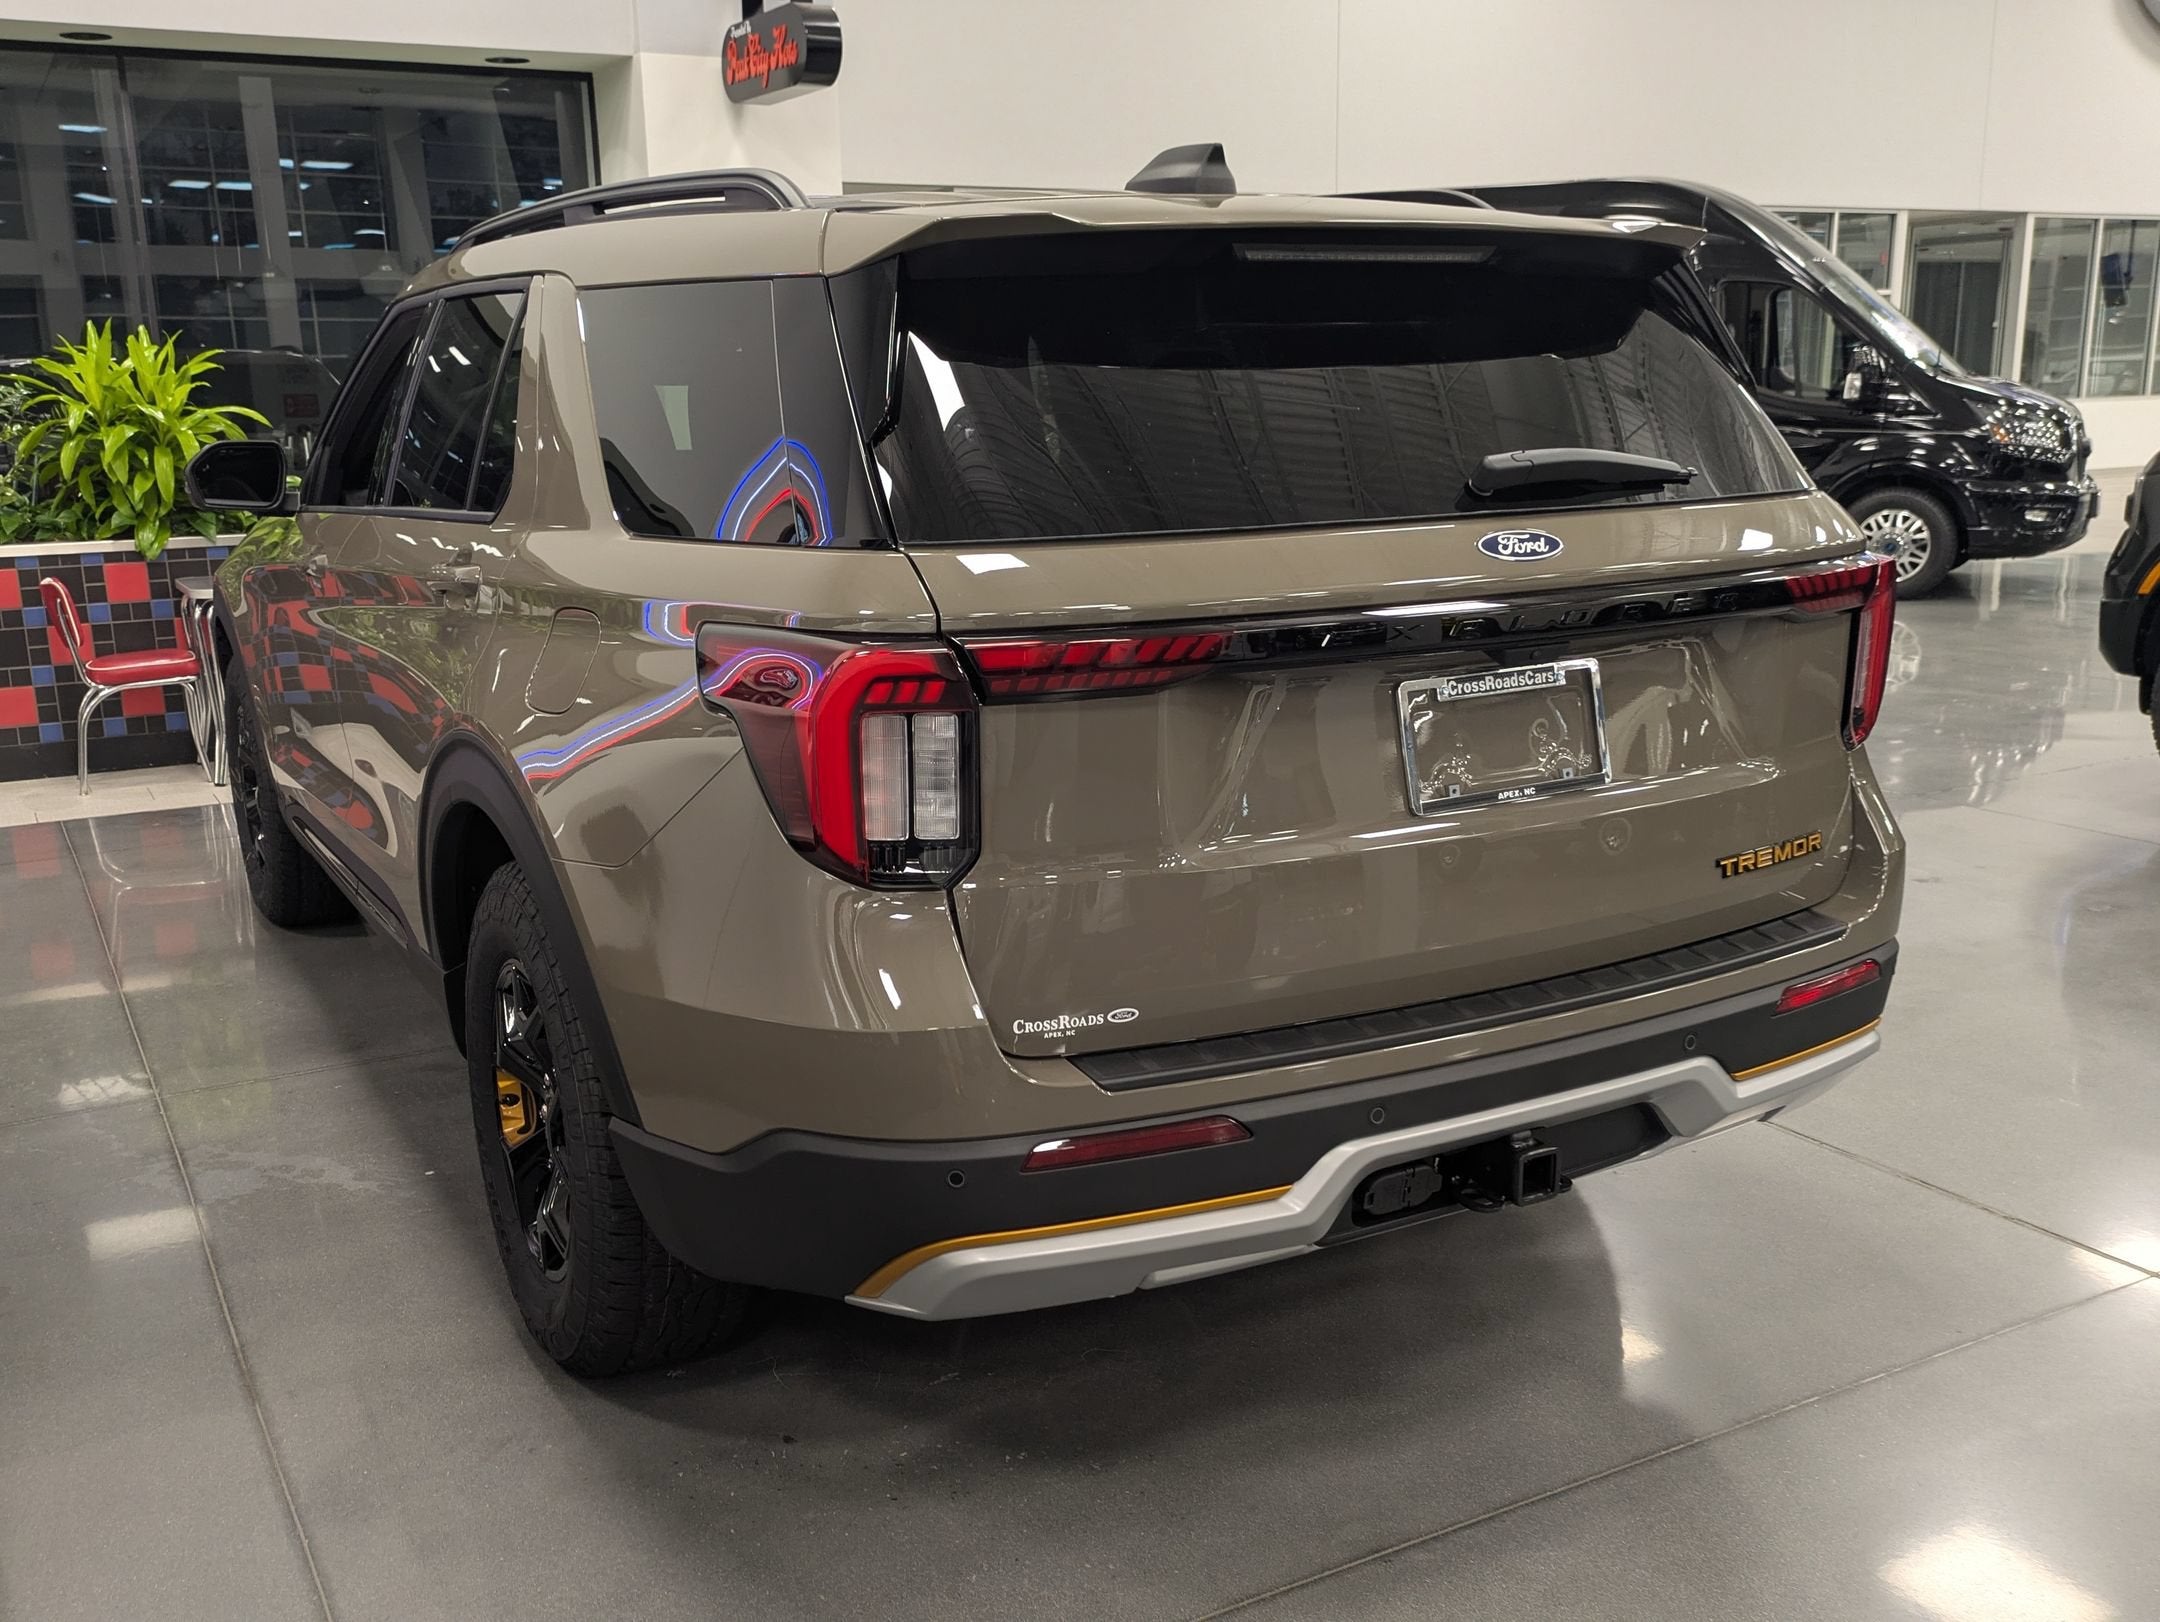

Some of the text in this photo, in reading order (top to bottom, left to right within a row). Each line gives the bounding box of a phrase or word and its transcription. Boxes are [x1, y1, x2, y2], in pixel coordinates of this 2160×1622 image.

[1497, 534, 1549, 555] Ford
[1449, 670, 1554, 696] CrossRoadsCars
[1524, 787, 1536, 797] NC
[1717, 831, 1822, 878] TREMOR
